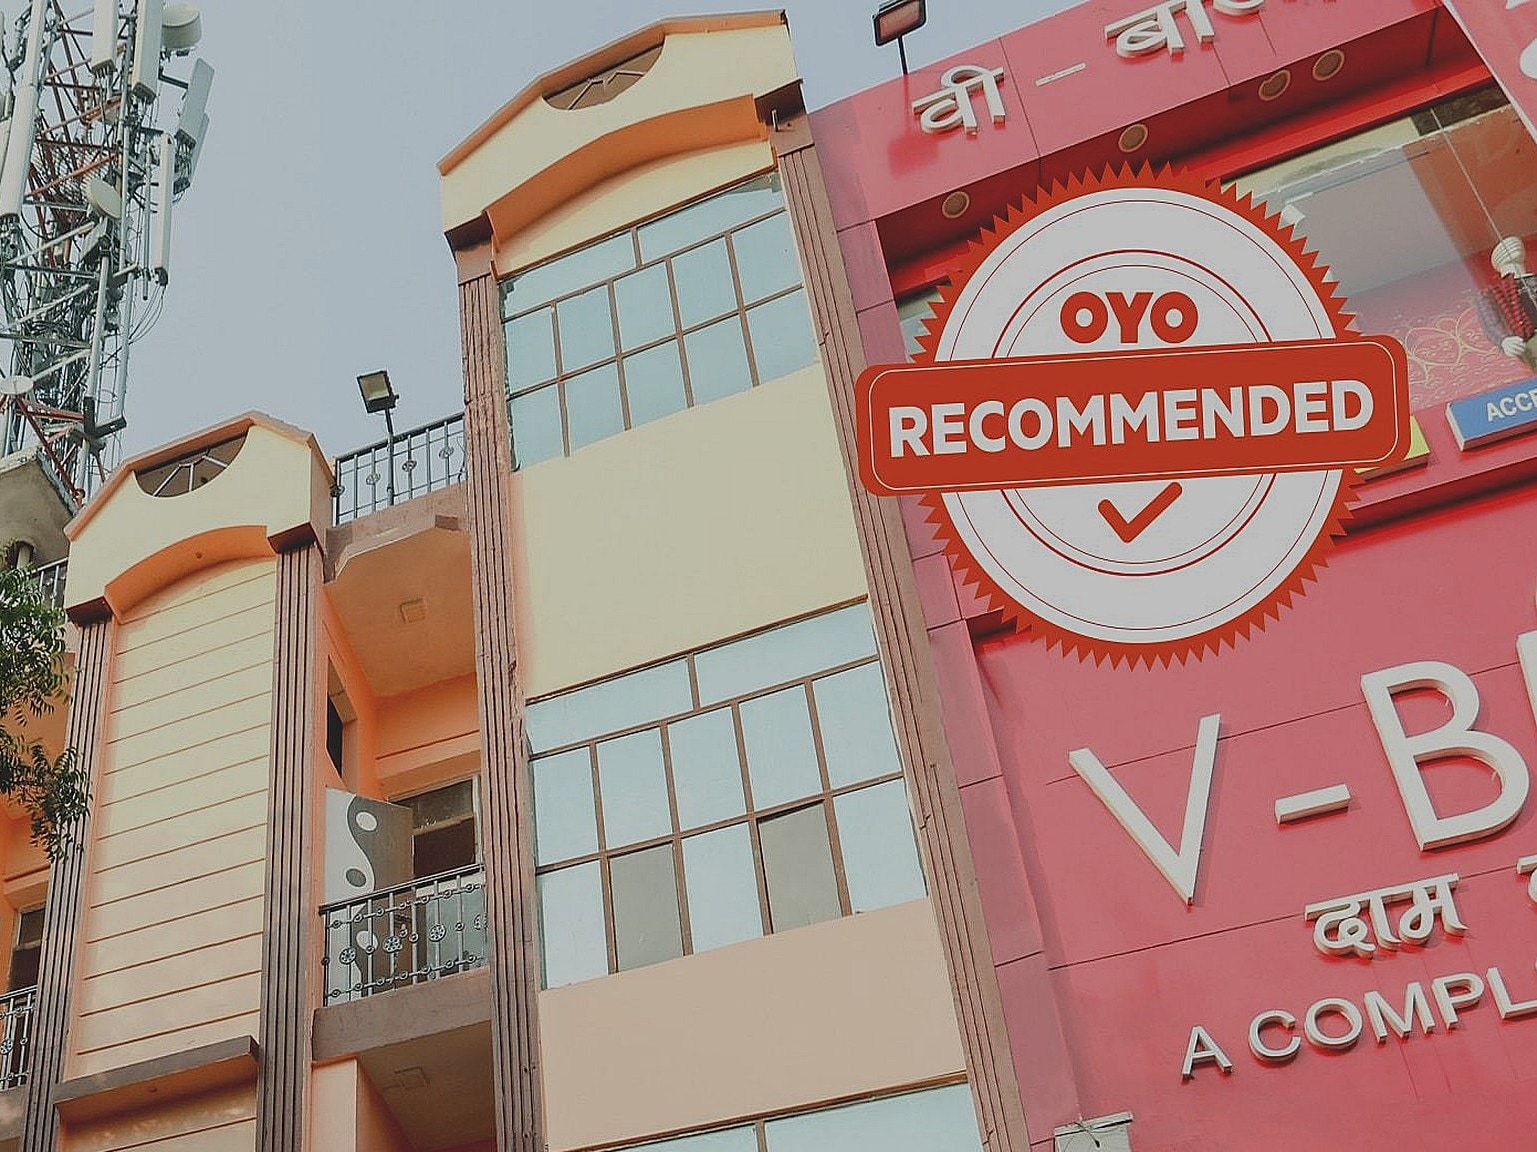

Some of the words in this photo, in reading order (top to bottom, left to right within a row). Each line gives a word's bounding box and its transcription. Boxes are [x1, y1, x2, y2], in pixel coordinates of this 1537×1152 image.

[912, 64, 1007, 136] वी
[1304, 872, 1470, 958] दाम
[1181, 1025, 1233, 1081] A
[1248, 958, 1537, 1063] COMPL
